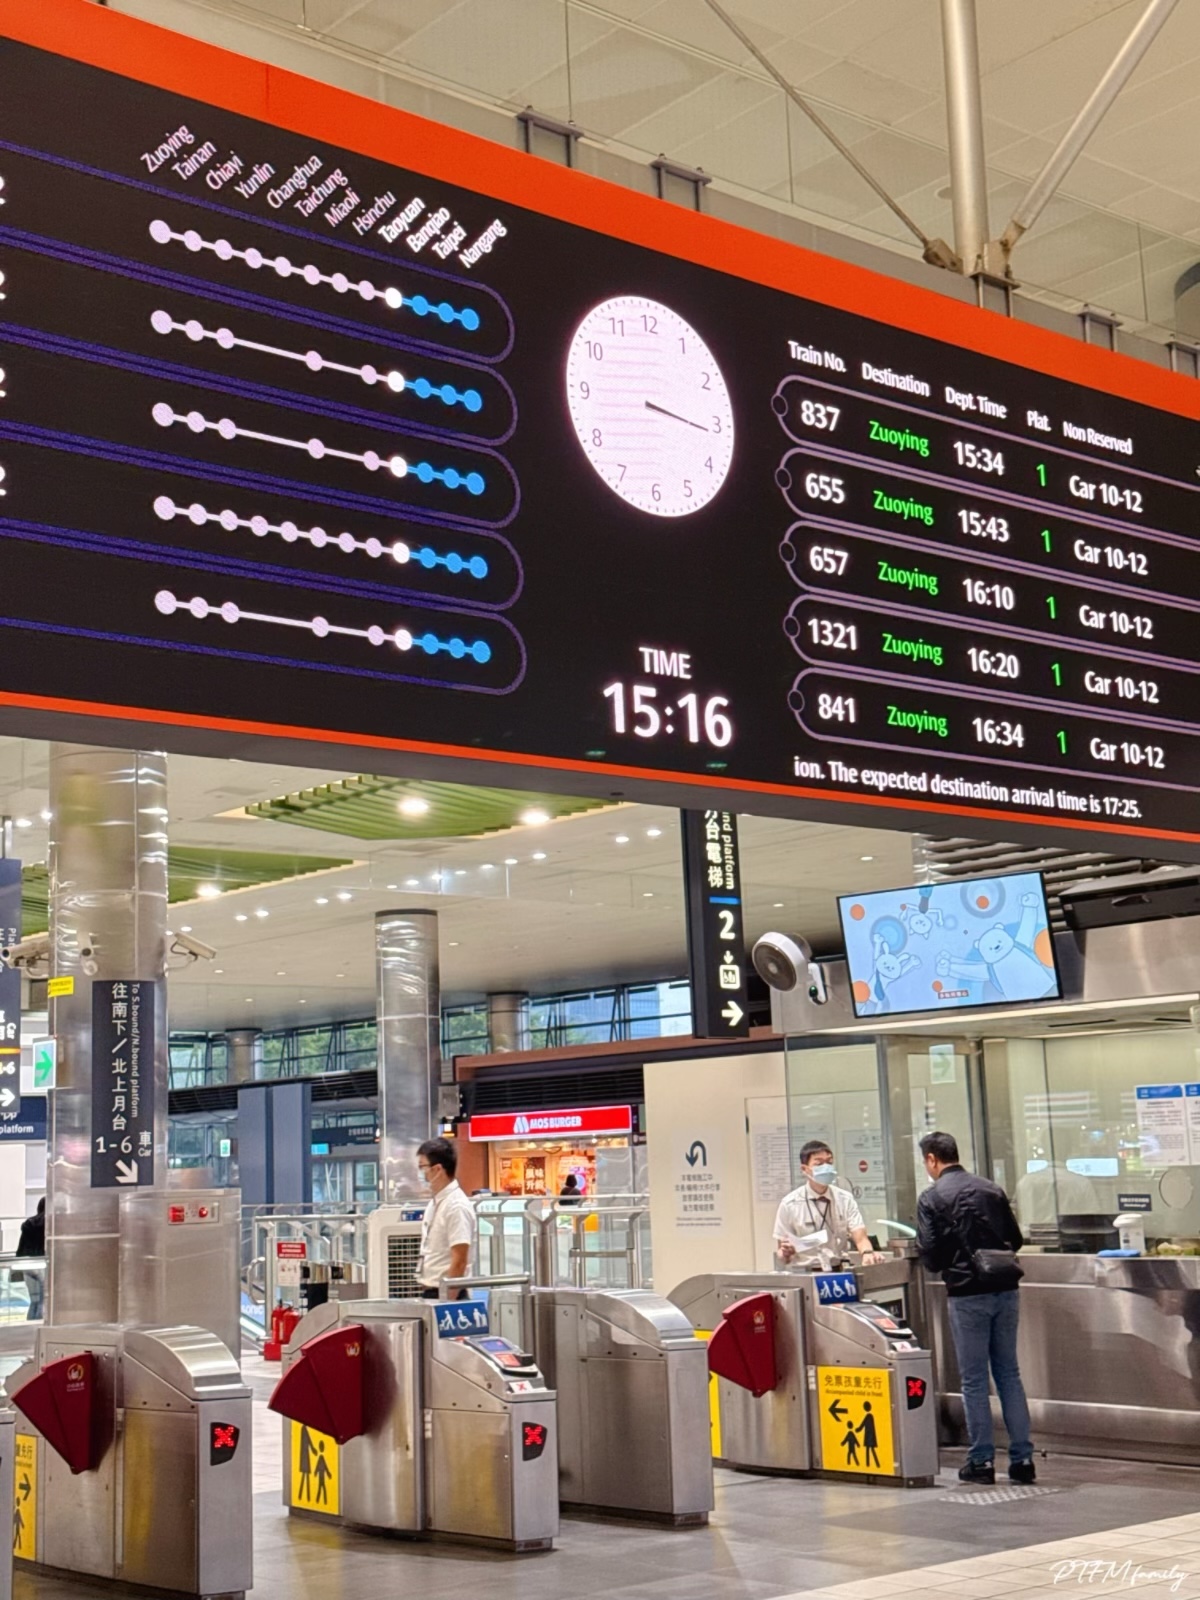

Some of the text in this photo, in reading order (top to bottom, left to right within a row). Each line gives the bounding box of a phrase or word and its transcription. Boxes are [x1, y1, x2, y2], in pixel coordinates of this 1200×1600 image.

[140, 125, 195, 173] Zuoying
[171, 141, 217, 180] Tainan
[206, 150, 244, 190] Chiayi
[234, 163, 276, 199] Yunlin
[267, 155, 323, 209] Changhua
[293, 168, 349, 218] Taichung
[324, 187, 361, 228] Miaoli
[352, 191, 397, 236] Hsinchu
[377, 197, 426, 243] Taoyuan
[406, 207, 451, 253] Banqiao
[431, 221, 467, 260] Taipei
[458, 219, 507, 269] Nangang
[608, 317, 625, 337] 11
[640, 314, 659, 335] 12
[584, 340, 603, 361] 10
[678, 337, 686, 355] 1
[580, 381, 590, 400] 9
[701, 371, 711, 391] 2
[787, 340, 1133, 455] Train No. Destination Dept. Time Plat. Non Reserved
[592, 428, 602, 447] 8
[712, 416, 722, 434] 3
[617, 463, 627, 482] 7
[704, 456, 713, 473] 4
[801, 400, 1143, 513] 837 Zuoying 15:34 1 Car 10-12
[651, 483, 661, 502] 6
[683, 479, 693, 498] 5
[805, 472, 1148, 576] 655 Zuoying 15:43 1 Car 10-12
[809, 545, 1154, 639] 657 Zuoying 16:10 1 Car 10-12
[638, 646, 692, 680] TIME
[807, 618, 1159, 704] 1321 Zuoying 16:20 1 Car 10-12
[602, 681, 733, 748] 15:16
[818, 693, 1165, 769] 841 Zuoying 16:34 1 Car 10-12
[794, 756, 1142, 819] ion. The expected destination arrival time is 17:25.
[722, 834, 736, 890] platform
[718, 910, 736, 941] 2
[131, 983, 140, 995] To
[131, 1079, 140, 1118] platform
[138, 1131, 152, 1147] 車
[529, 1116, 582, 1130] MOS BURGER
[95, 1136, 133, 1154] 1-6
[138, 1148, 152, 1157] Car
